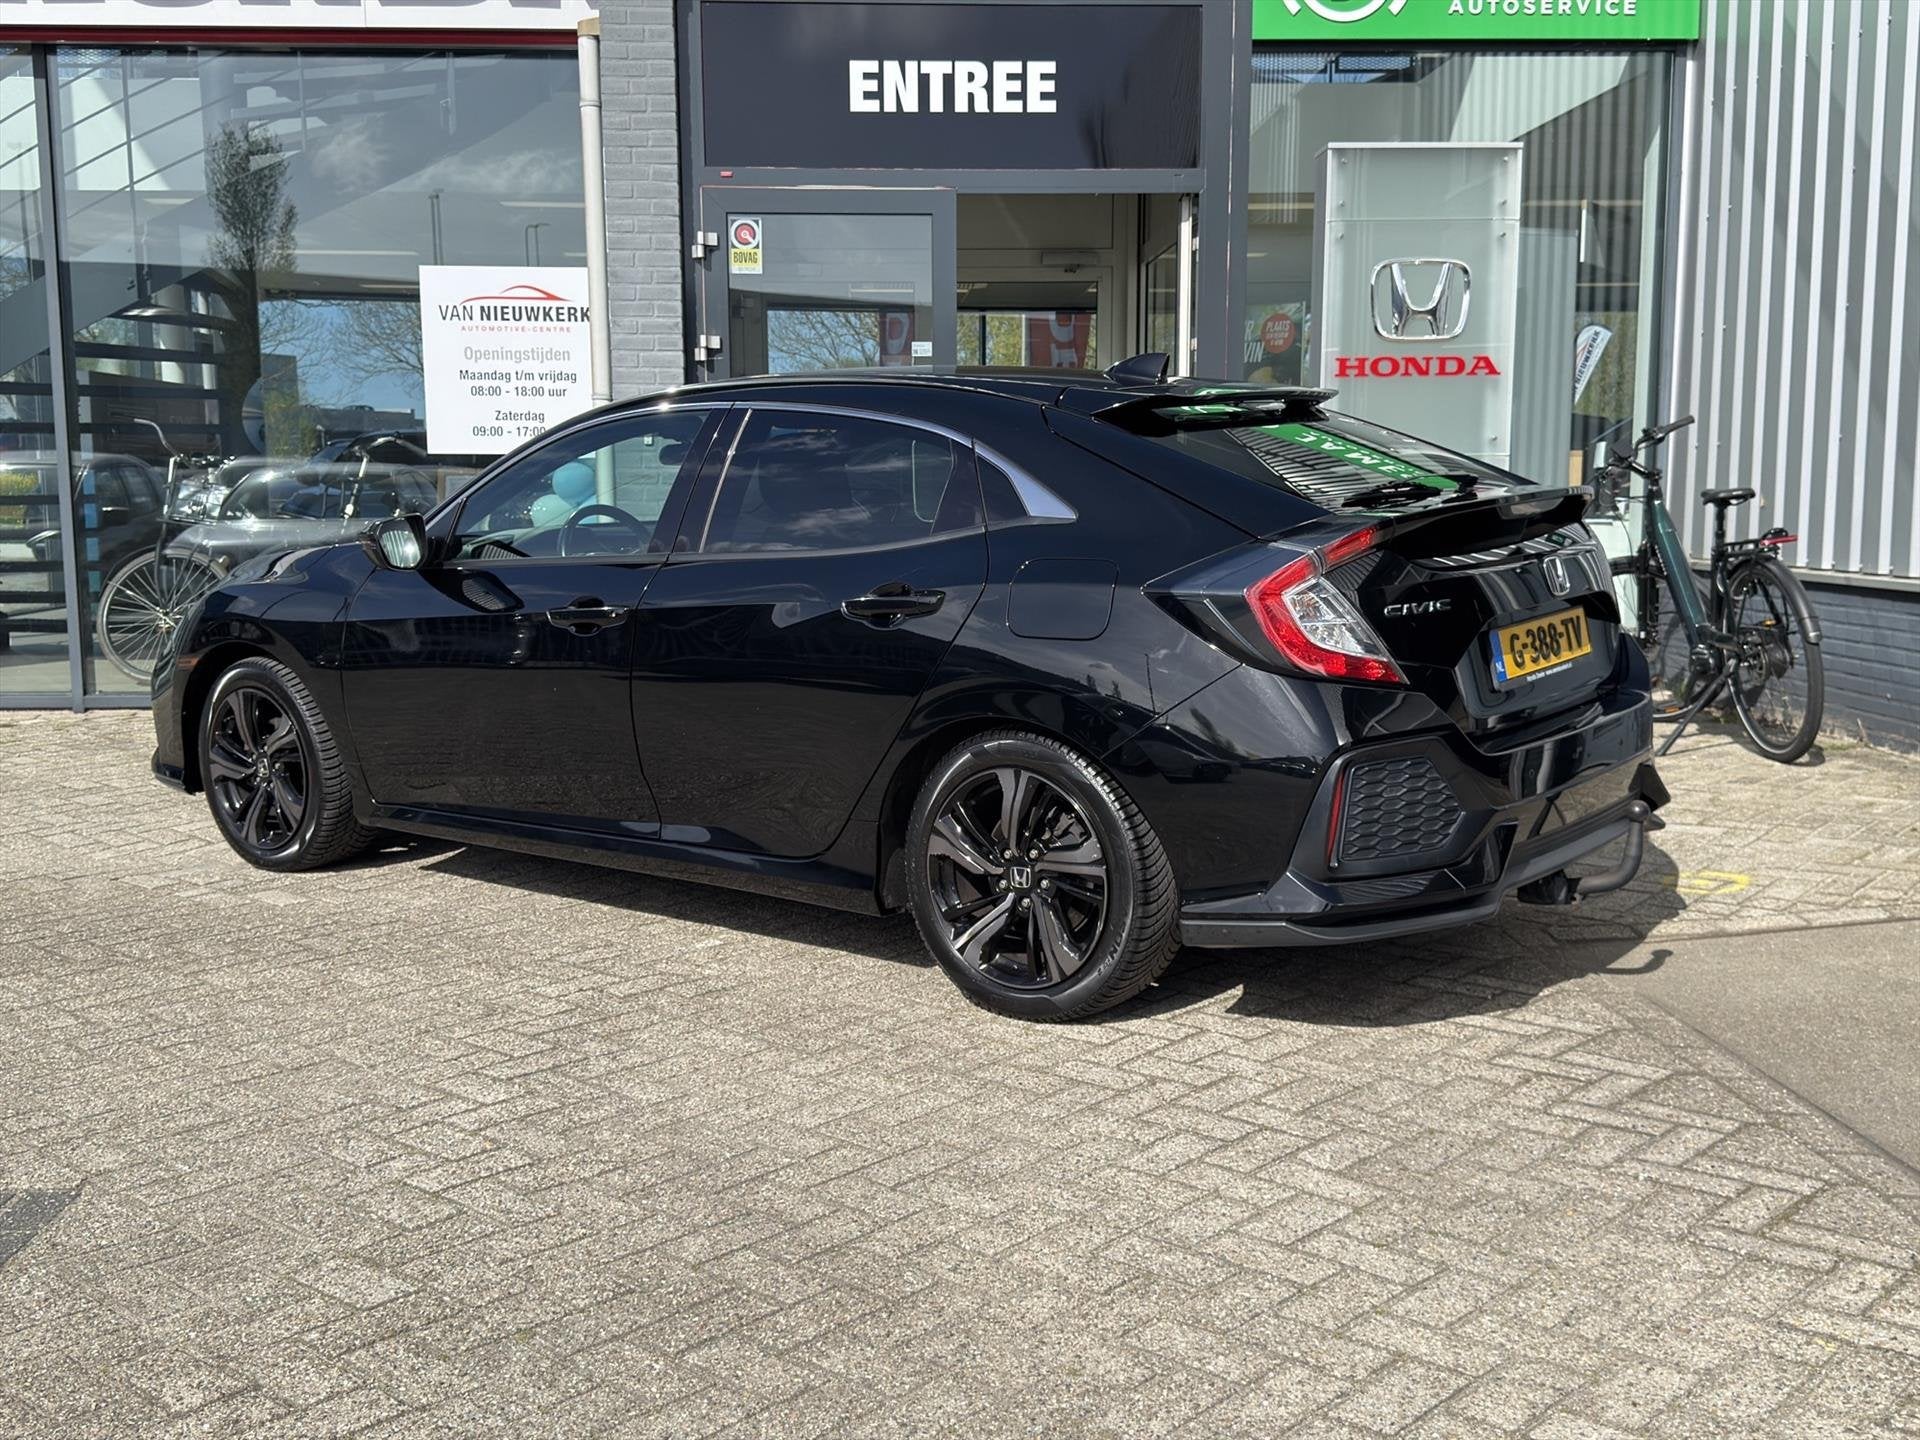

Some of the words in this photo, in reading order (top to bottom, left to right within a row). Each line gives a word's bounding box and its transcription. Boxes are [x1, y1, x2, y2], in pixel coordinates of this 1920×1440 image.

[1448, 0, 1637, 15] AUTOSERVICE
[849, 60, 1057, 113] ENTREE
[733, 251, 758, 264] BOVAG
[438, 305, 473, 321] VAN
[480, 306, 590, 322] NIEUWKERK
[461, 325, 571, 333] AUTOMOTIVE-CENTRE
[463, 346, 571, 363] Openingstijden
[1335, 355, 1501, 378] HONDA
[459, 370, 512, 382] Maandag
[515, 371, 535, 381] t/m
[538, 371, 577, 383] vrijdag
[470, 386, 502, 397] 08:00
[514, 386, 545, 397] 18:00
[548, 388, 568, 397] uur
[494, 410, 545, 422] Zaterdag
[472, 426, 504, 437] 09:00
[1384, 598, 1452, 616] CIVIC
[1509, 615, 1583, 669] G-388-TV
